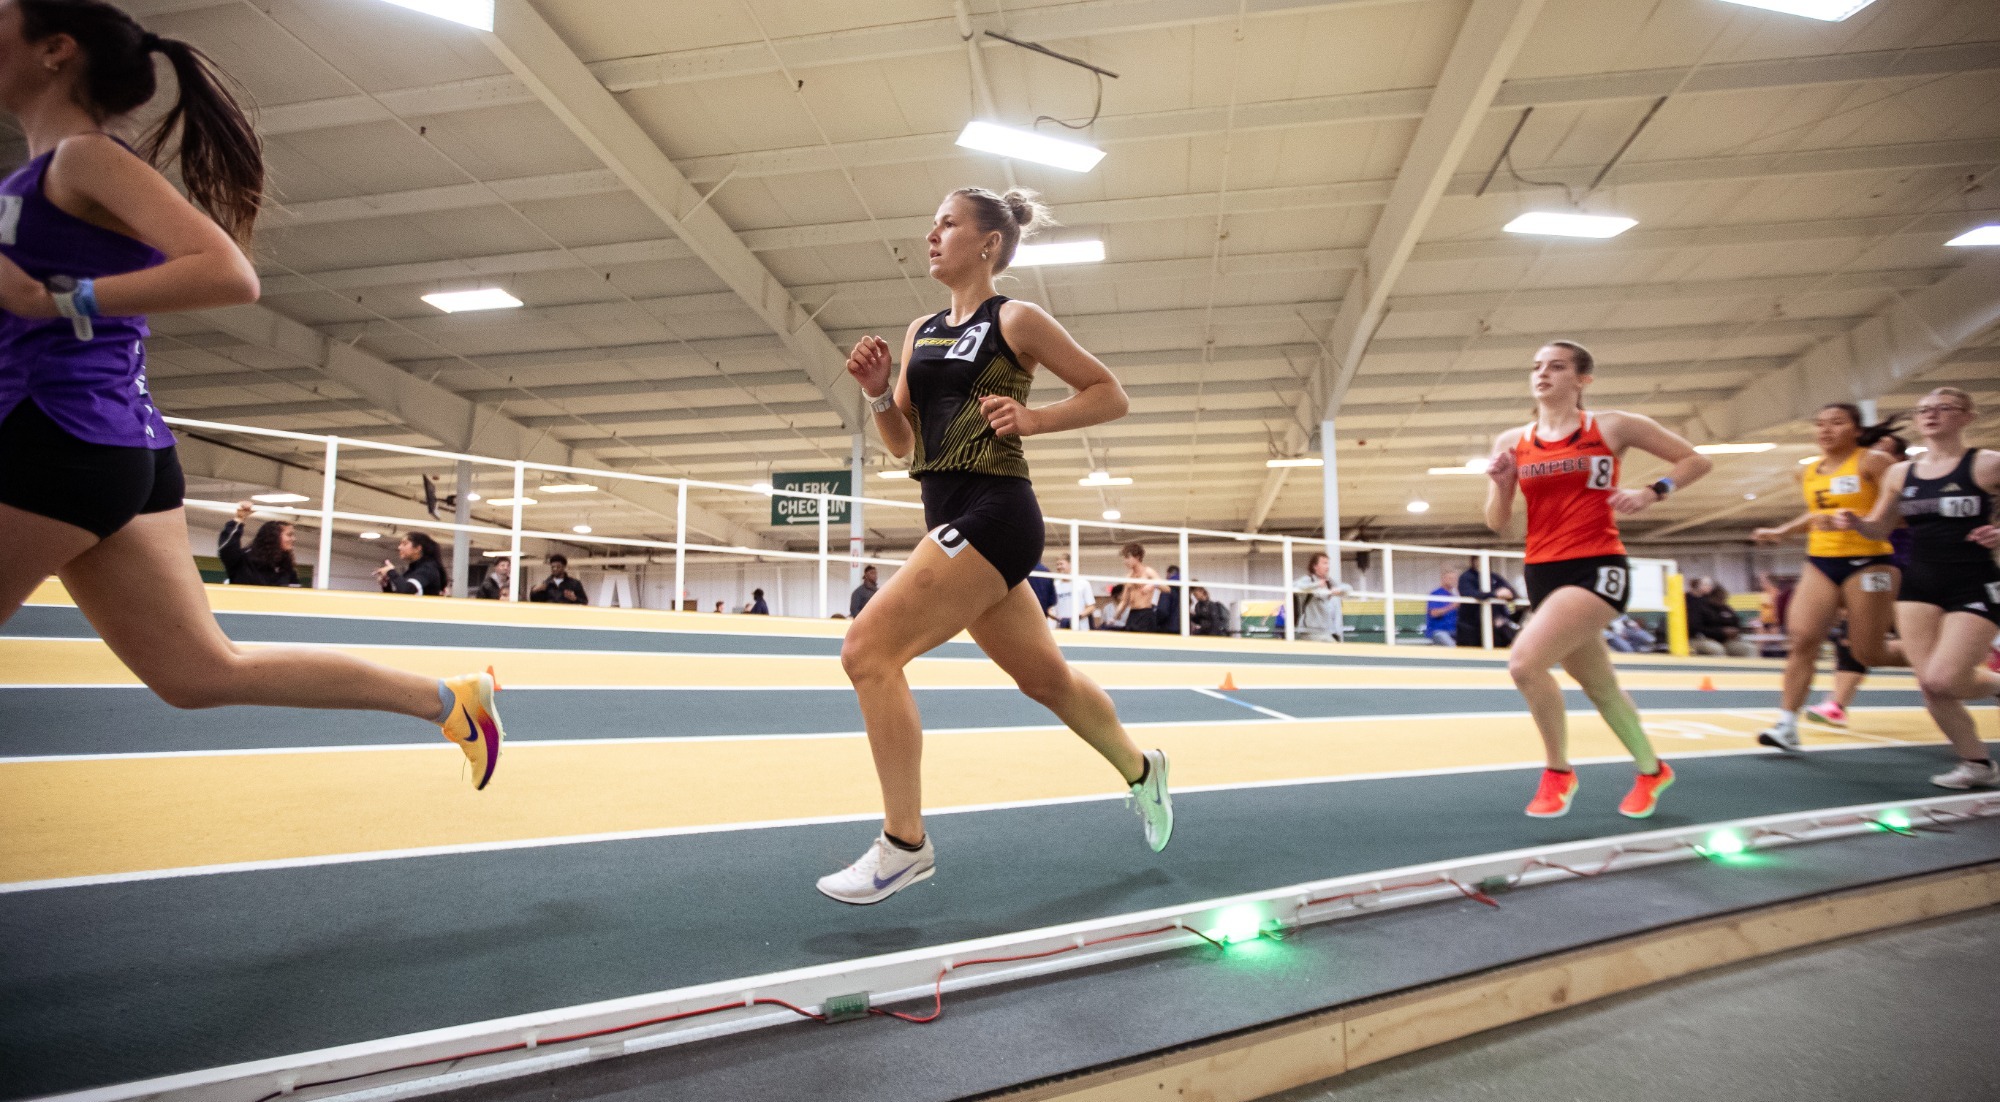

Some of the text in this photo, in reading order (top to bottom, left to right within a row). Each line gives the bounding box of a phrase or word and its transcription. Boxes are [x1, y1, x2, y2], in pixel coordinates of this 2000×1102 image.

[952, 326, 982, 357] 6
[1595, 458, 1611, 488] 8
[1949, 498, 1974, 517] 10
[599, 574, 633, 608] A
[1605, 569, 1620, 594] 8
